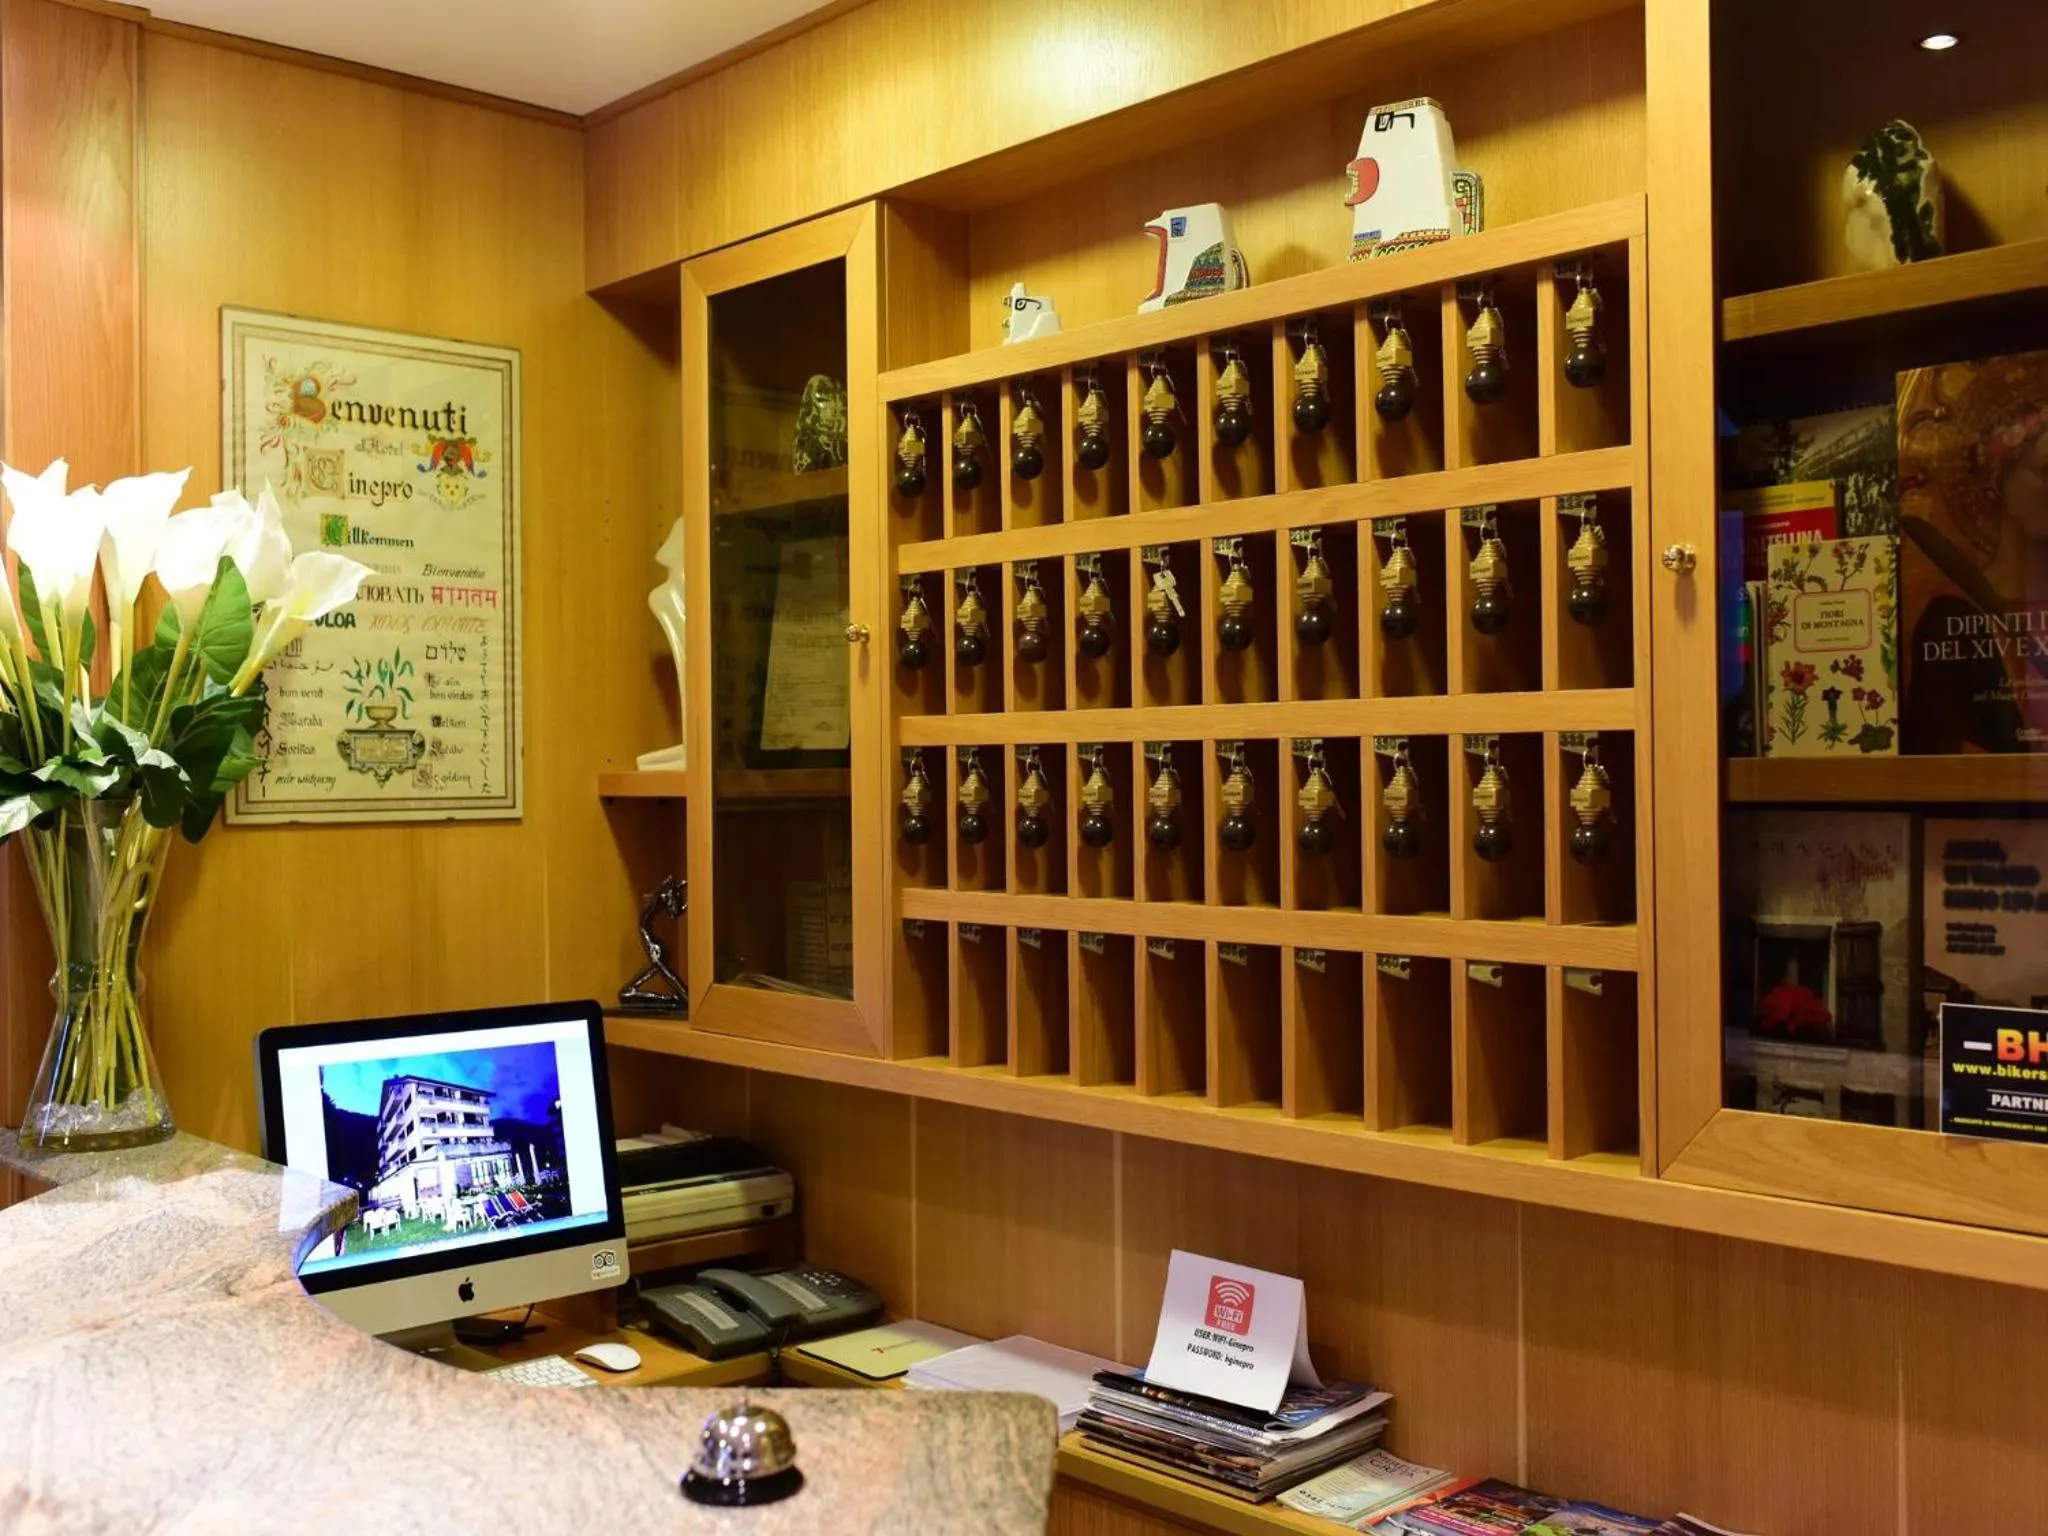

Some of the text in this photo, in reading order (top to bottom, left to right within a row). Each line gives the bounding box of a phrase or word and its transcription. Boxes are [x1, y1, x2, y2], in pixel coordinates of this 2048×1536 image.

[291, 374, 468, 435] Benvenuti
[1801, 622, 1811, 630] DI
[1945, 611, 2033, 637] DIPINTI
[1923, 641, 1967, 662] DEL
[1971, 636, 2011, 660] XIV
[2016, 636, 2029, 657] E
